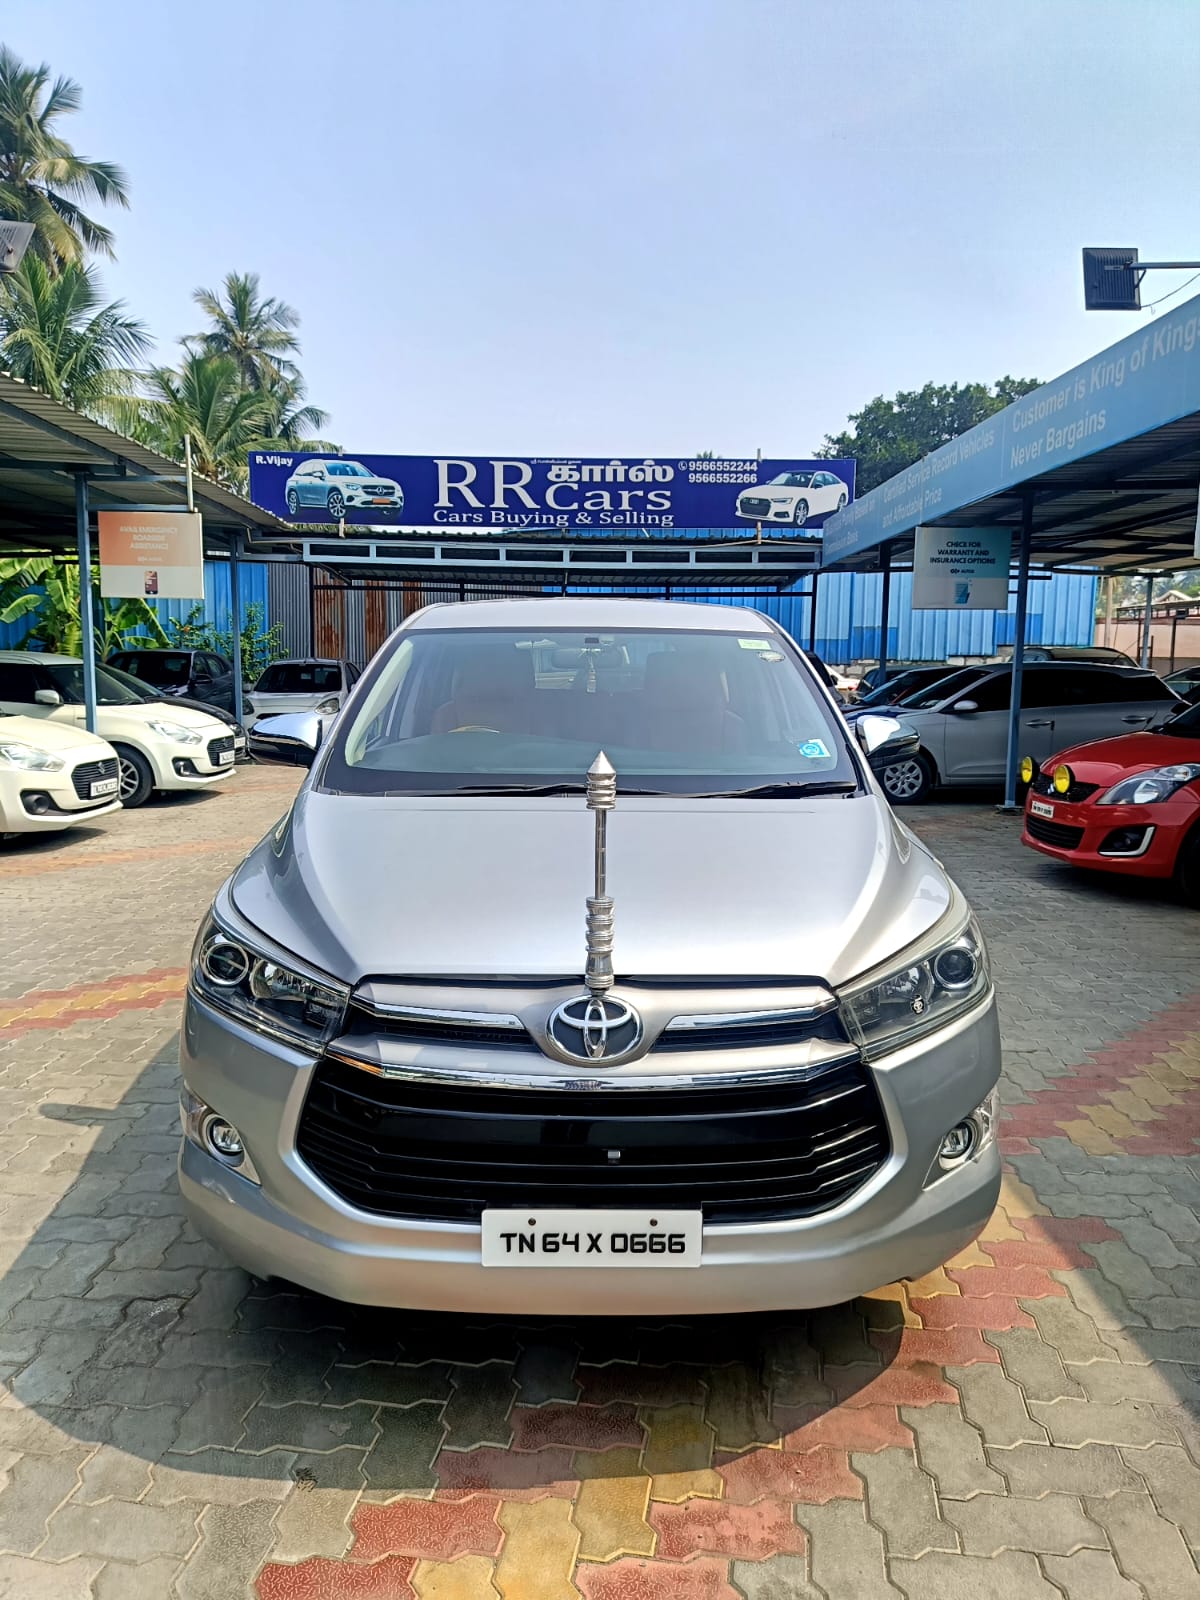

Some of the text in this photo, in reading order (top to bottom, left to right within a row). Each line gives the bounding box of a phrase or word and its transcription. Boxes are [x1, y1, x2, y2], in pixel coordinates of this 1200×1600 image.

[1012, 386, 1071, 433] Customer
[1074, 377, 1086, 402] is
[1090, 357, 1126, 393] King
[1130, 337, 1149, 372] of
[1010, 409, 1106, 469] Never Bargains
[255, 455, 294, 467] R.Vijay
[547, 460, 675, 482] கார்ஸ்
[688, 461, 758, 472] 9566552244
[433, 459, 541, 509] RR
[688, 473, 758, 484] 9566552266
[545, 483, 672, 510] Cars
[433, 509, 675, 527] Cars Buying & Selling
[967, 557, 996, 565] OPTIONS
[500, 1232, 686, 1253] TN 64 X 0666
